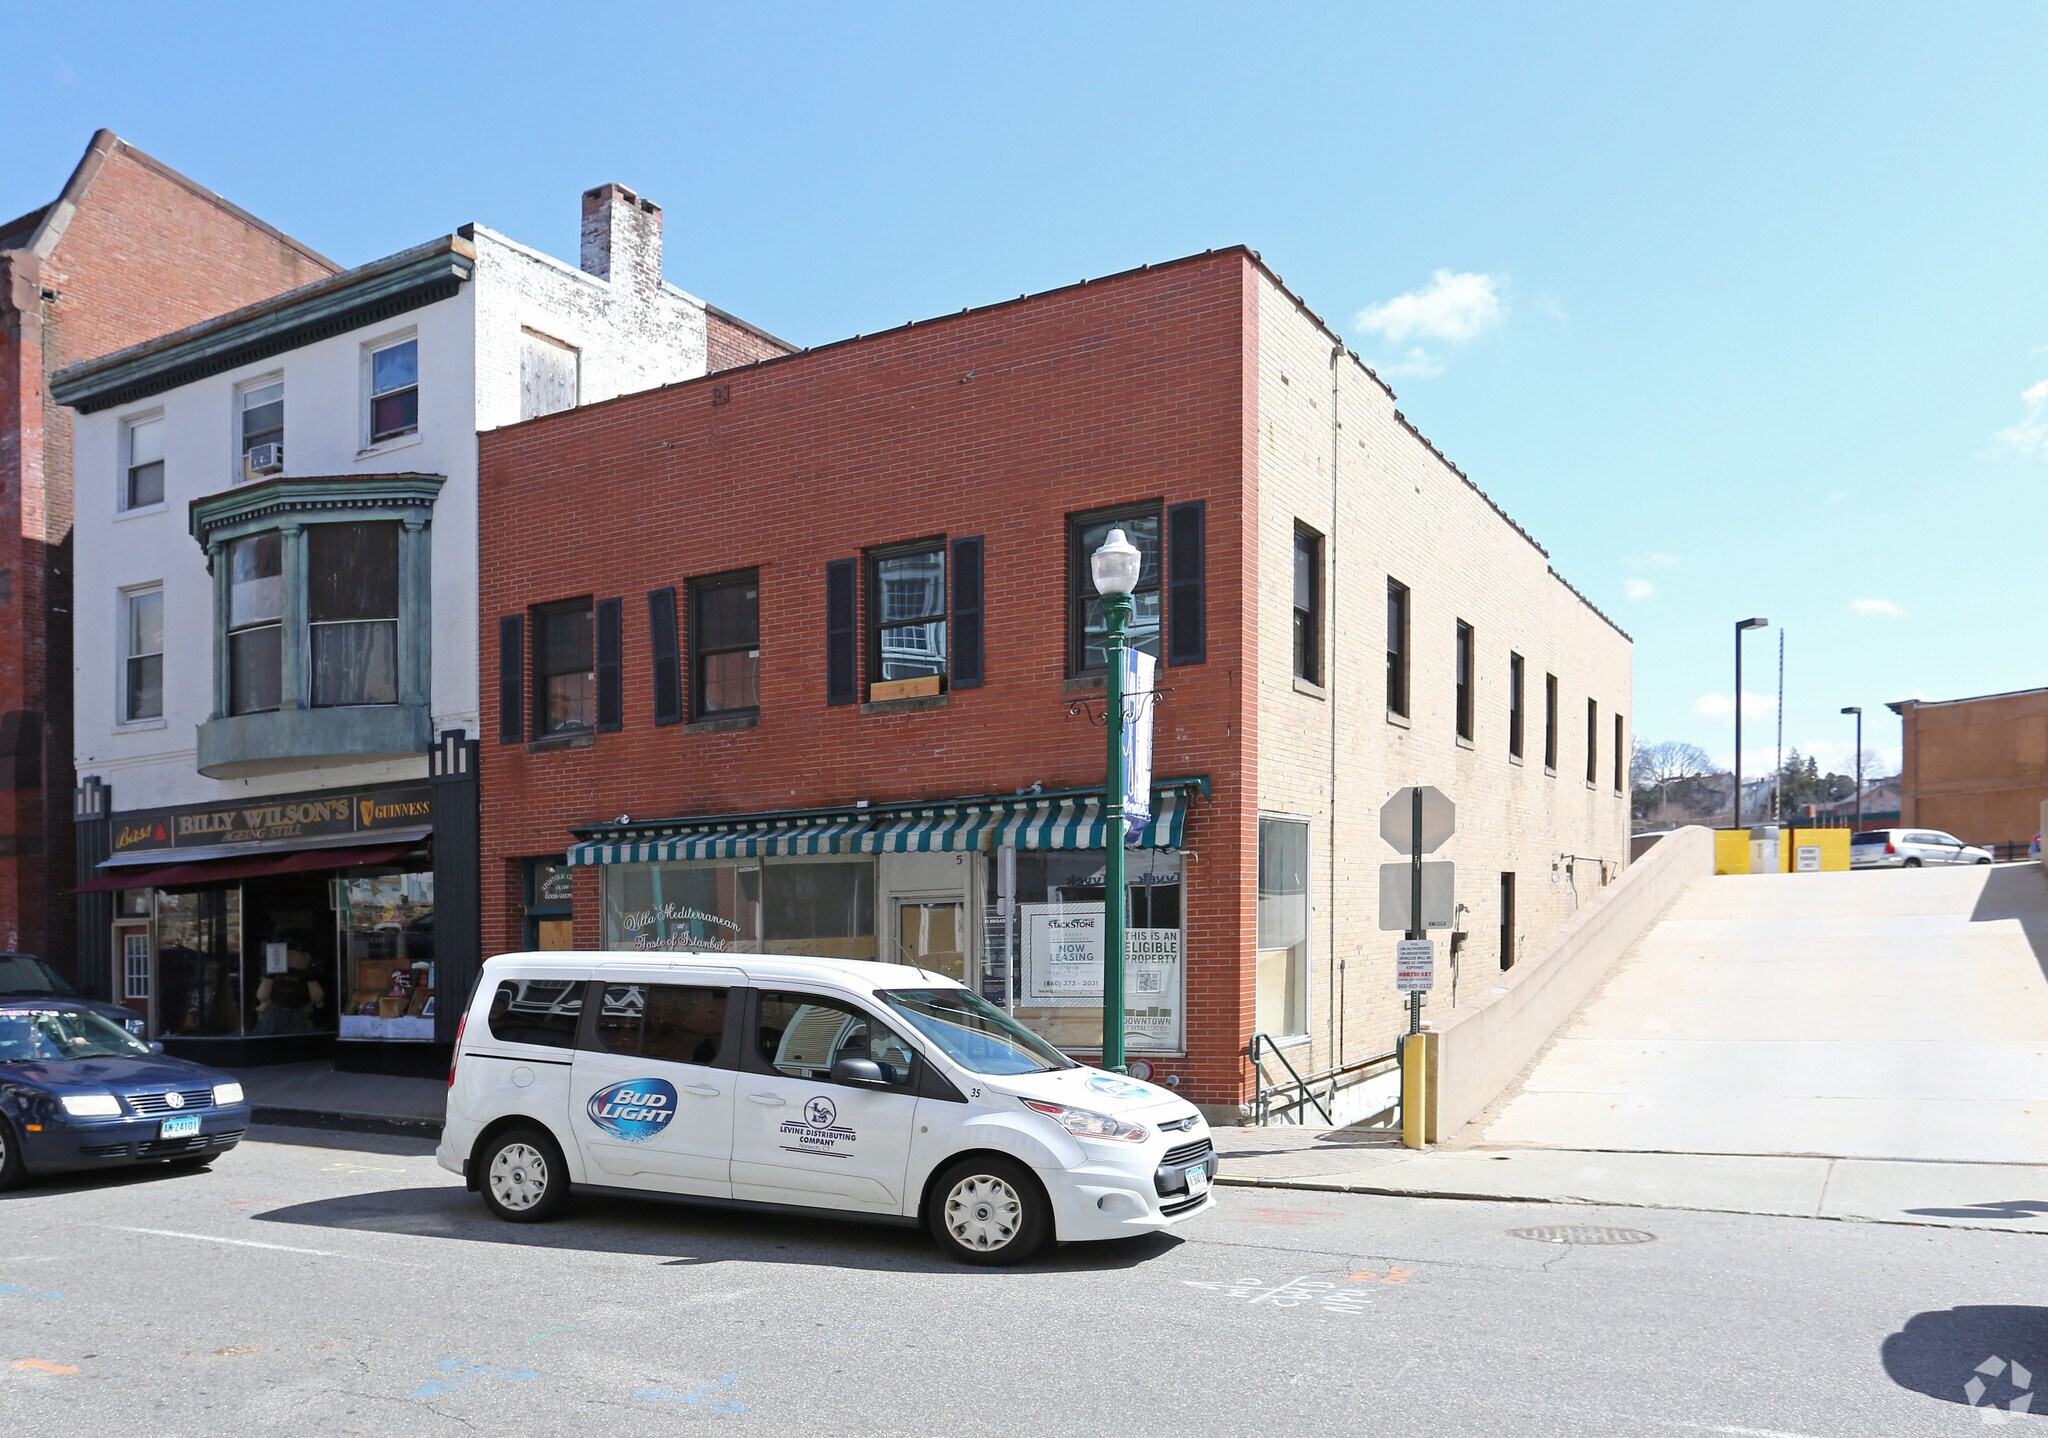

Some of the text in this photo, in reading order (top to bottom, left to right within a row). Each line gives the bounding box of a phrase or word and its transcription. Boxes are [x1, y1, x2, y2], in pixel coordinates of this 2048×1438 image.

[374, 801, 430, 819] GUINNESS
[178, 799, 349, 835] BILLY WILSON'S
[115, 824, 152, 849] Bass
[623, 903, 740, 932] Villa Mediterranean
[1048, 921, 1095, 929] STACKSTONE
[634, 931, 726, 951] Taste of Istanbul
[1125, 931, 1177, 941] THIS IS AN
[1058, 944, 1085, 952] NOW
[1125, 942, 1177, 953] ELIGIBLE
[1049, 952, 1094, 961] LEASING
[1125, 954, 1177, 964] PROPERTY
[1043, 980, 1061, 988] (860)
[1124, 1017, 1171, 1025] DOWNTOWN
[612, 1089, 668, 1107] BUD
[970, 1088, 981, 1098] 35
[600, 1103, 673, 1123] LIGHT
[780, 1126, 856, 1141] LEVINE DISTRIBUTING
[799, 1136, 835, 1146] COMPANY
